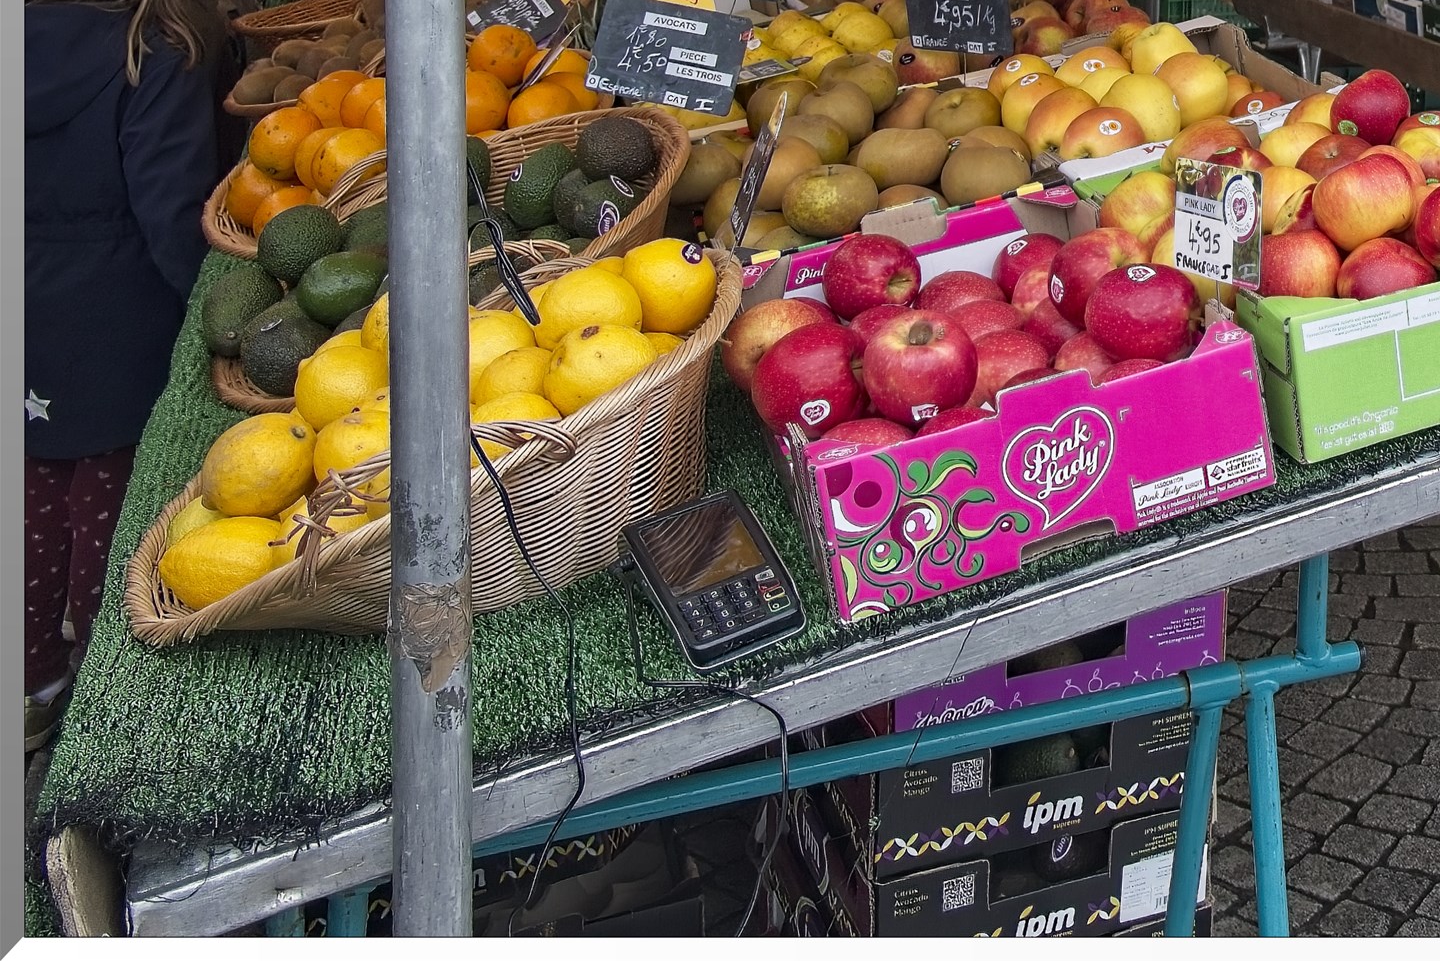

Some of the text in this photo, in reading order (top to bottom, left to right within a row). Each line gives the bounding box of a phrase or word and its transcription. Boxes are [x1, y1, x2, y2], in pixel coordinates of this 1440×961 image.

[653, 16, 697, 31] AVOCATS
[969, 43, 982, 51] CAT
[680, 51, 707, 63] PIECE
[676, 67, 693, 77] LES
[695, 69, 722, 82] TROIS
[667, 94, 685, 104] CAT
[693, 99, 715, 111] I
[1184, 197, 1216, 213] PINK LADY
[1221, 264, 1231, 279] I
[1362, 406, 1399, 422] Organic
[1379, 421, 1394, 434] BIO
[1024, 418, 1091, 481] Pink
[1036, 446, 1099, 499] Lady
[1154, 476, 1183, 489] ASSOCIATION
[1138, 493, 1159, 506] Pink
[1161, 485, 1182, 499] Lady
[1166, 711, 1192, 723] SUPREM
[904, 769, 928, 779] Citrus
[903, 775, 938, 788] Avocado
[903, 786, 930, 797] Mango
[1023, 791, 1084, 834] ipm
[1053, 817, 1081, 830] supreme
[1158, 820, 1178, 831] SUPRE
[894, 888, 919, 899] Citrus
[894, 894, 929, 909] Avocado
[893, 905, 921, 917] Mango
[1016, 905, 1075, 937] ipm
